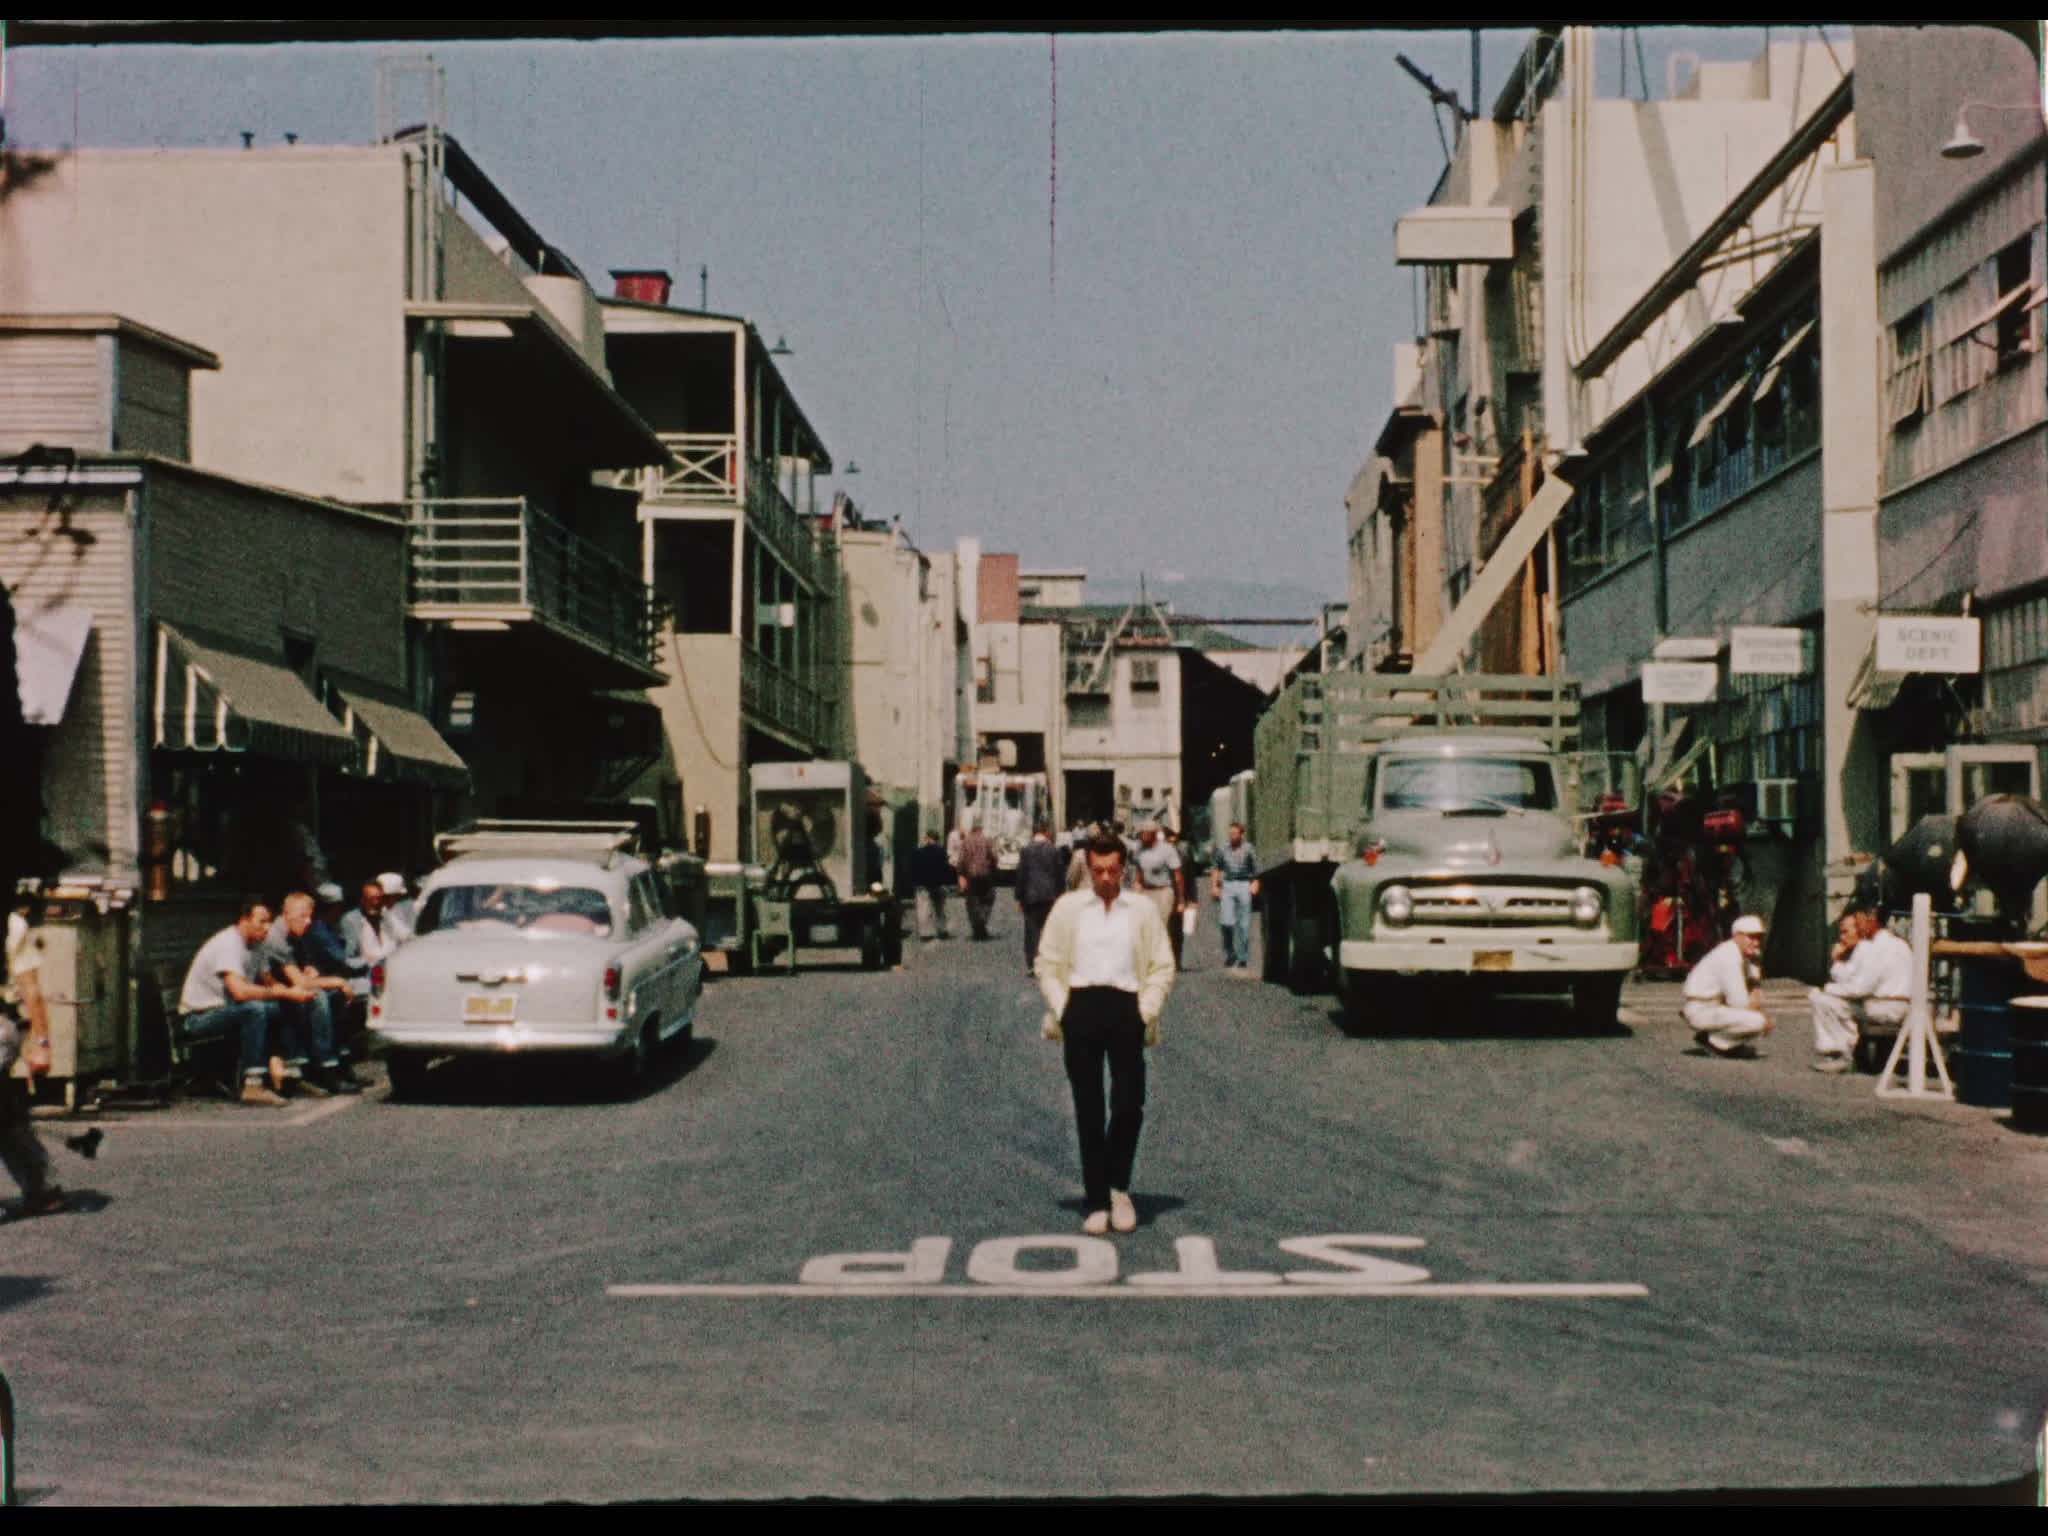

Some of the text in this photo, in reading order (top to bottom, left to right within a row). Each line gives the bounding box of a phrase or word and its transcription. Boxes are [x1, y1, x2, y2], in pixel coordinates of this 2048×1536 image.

[1897, 627, 1957, 643] SCENIC
[1905, 646, 1951, 661] DEPT
[801, 1234, 1431, 1284] STOP
